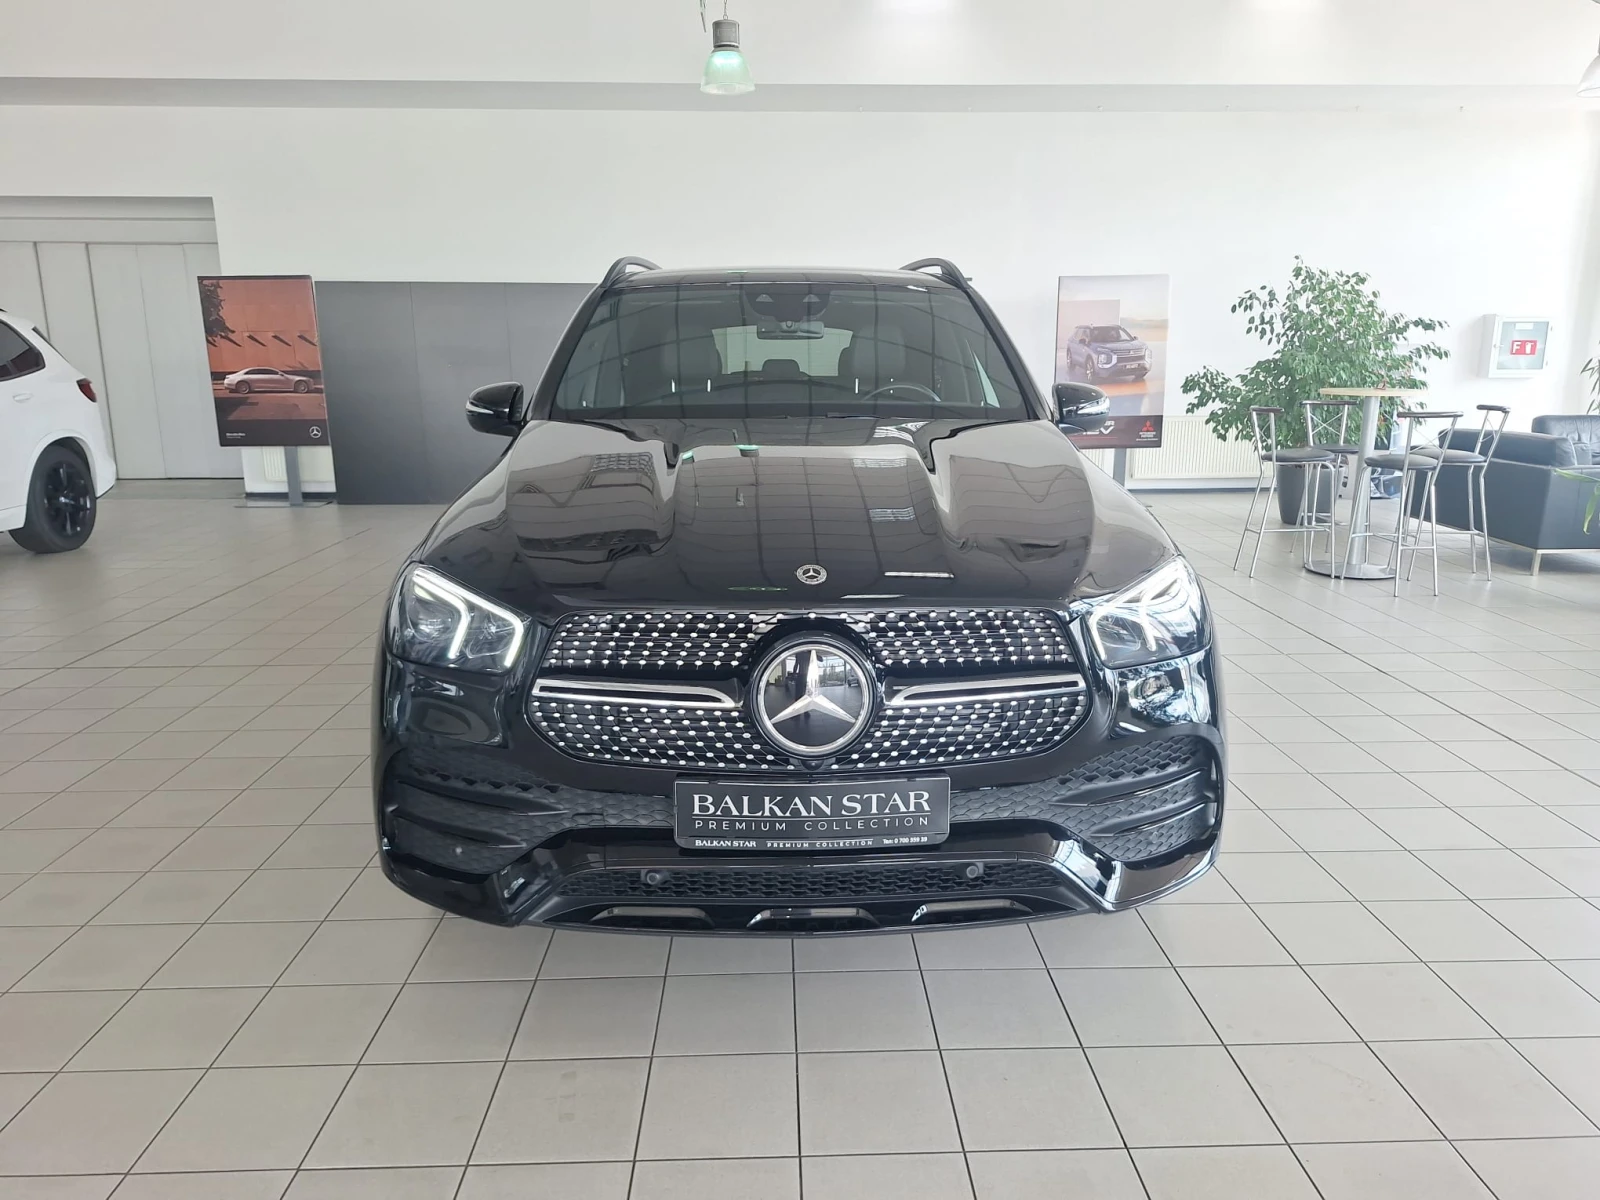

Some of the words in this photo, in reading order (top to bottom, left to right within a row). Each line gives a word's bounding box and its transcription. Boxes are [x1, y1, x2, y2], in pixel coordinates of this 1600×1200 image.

[692, 794, 832, 816] BALKAN
[841, 791, 931, 815] STAR
[695, 820, 787, 831] PREMIUM
[804, 816, 928, 831] COLLECTION
[695, 839, 731, 847] BALKAN
[732, 840, 757, 848] STAR
